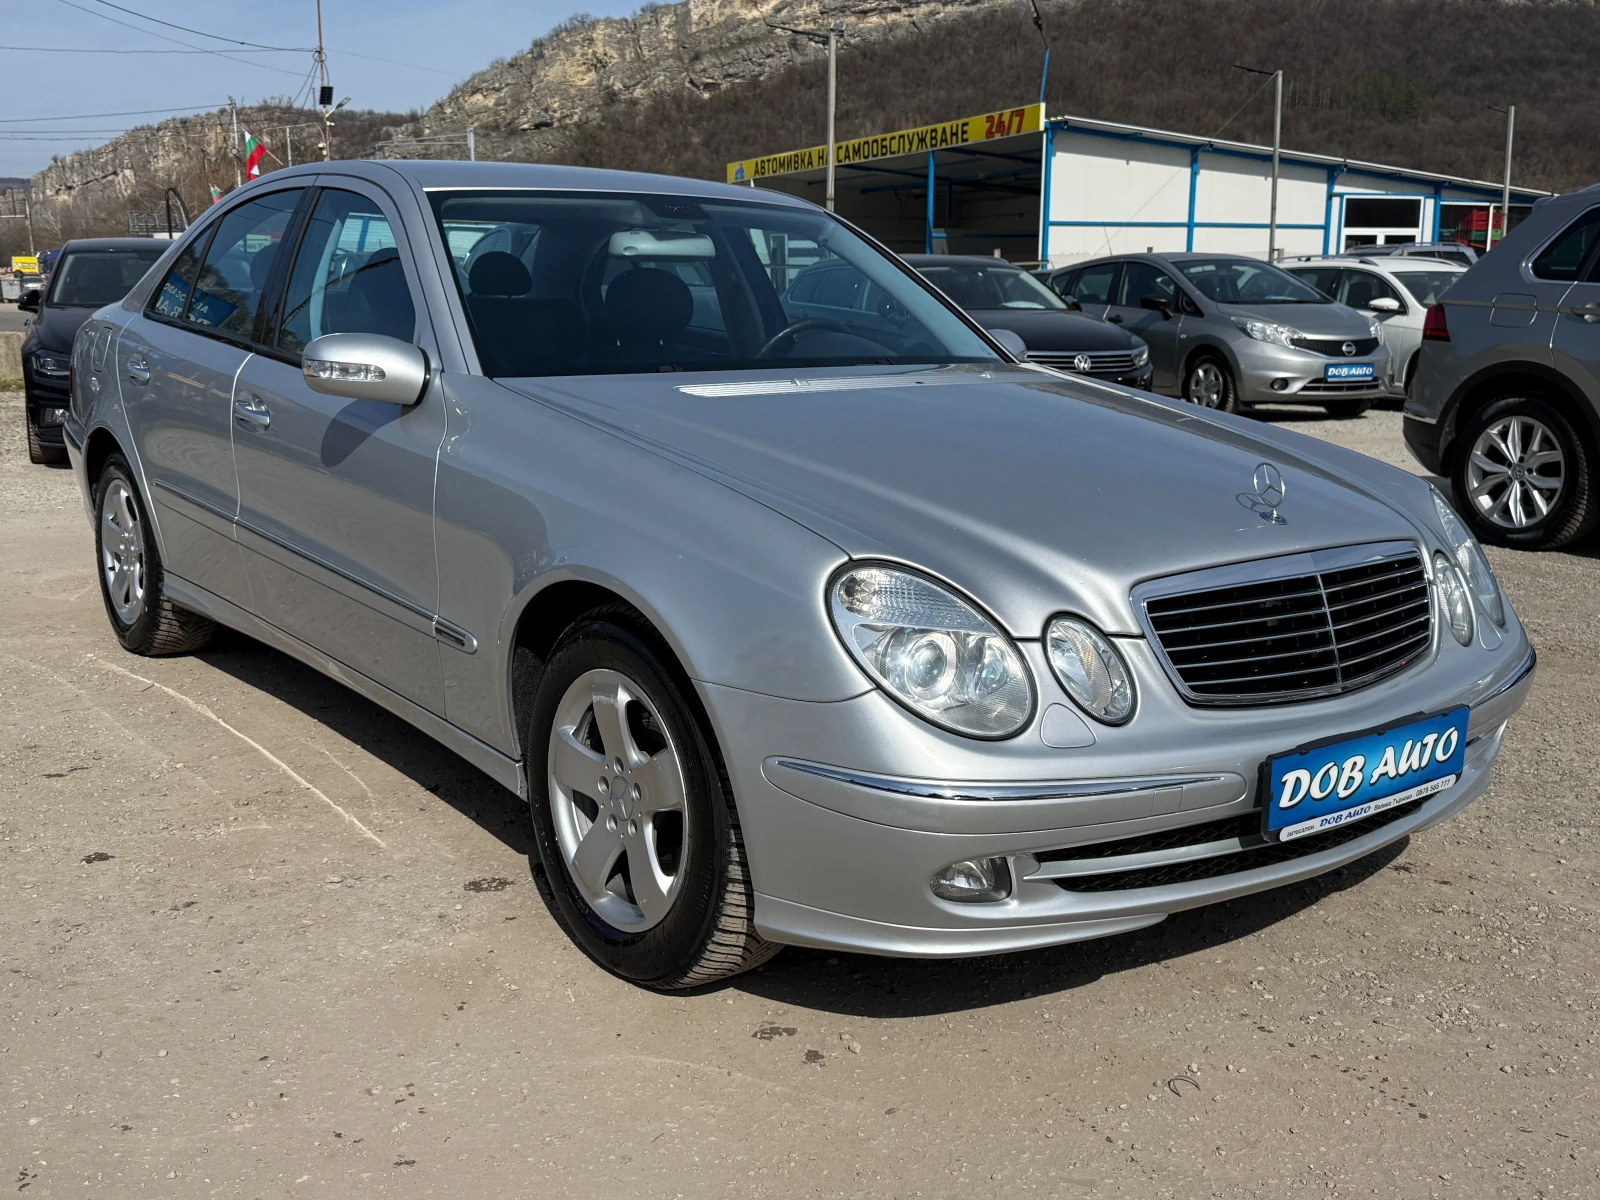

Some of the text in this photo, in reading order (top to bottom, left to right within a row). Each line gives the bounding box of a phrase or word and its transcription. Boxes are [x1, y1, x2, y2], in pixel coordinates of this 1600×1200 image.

[753, 152, 814, 177] АВТОМИВКА
[837, 122, 969, 164] САМООБСЛУЖВАНЕ
[985, 109, 1025, 139] 24/7
[1327, 366, 1373, 377] DOB AUTO
[1278, 727, 1459, 809] DOB AUTO
[1286, 824, 1315, 838] автосалон
[1320, 814, 1344, 828] DOB
[1344, 805, 1372, 820] AUTO
[1441, 779, 1451, 788] 777
